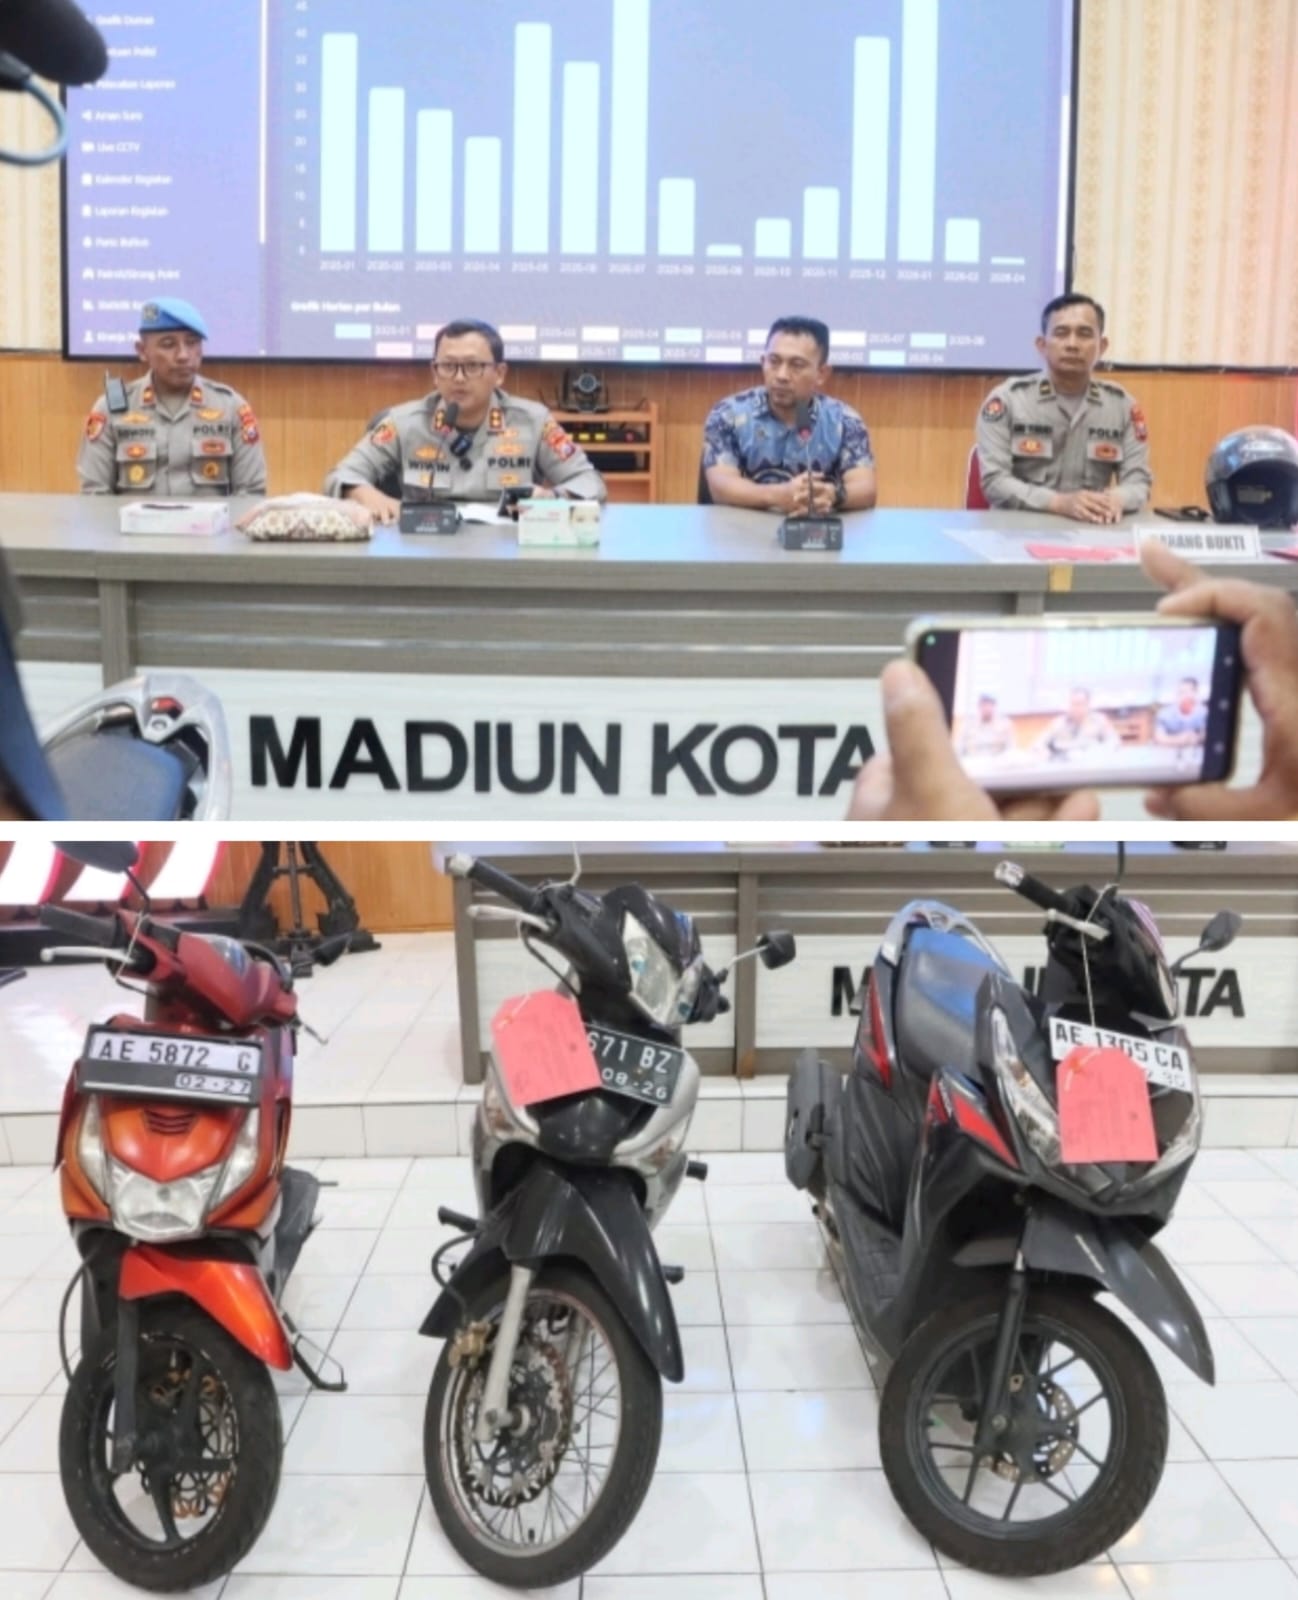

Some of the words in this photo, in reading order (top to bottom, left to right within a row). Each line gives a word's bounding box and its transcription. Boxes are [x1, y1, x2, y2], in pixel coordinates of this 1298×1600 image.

[116, 142, 140, 152] CCTV
[193, 423, 229, 435] POLRI
[488, 457, 531, 469] POLRI
[1205, 534, 1246, 550] BUKTI
[249, 715, 622, 796] MADIUN
[652, 722, 878, 796] KOTA
[99, 1039, 135, 1061] AE
[149, 1041, 211, 1070] 5872
[1055, 1023, 1084, 1046] AE
[1154, 1047, 1184, 1072] CA
[639, 1046, 673, 1074] BZ
